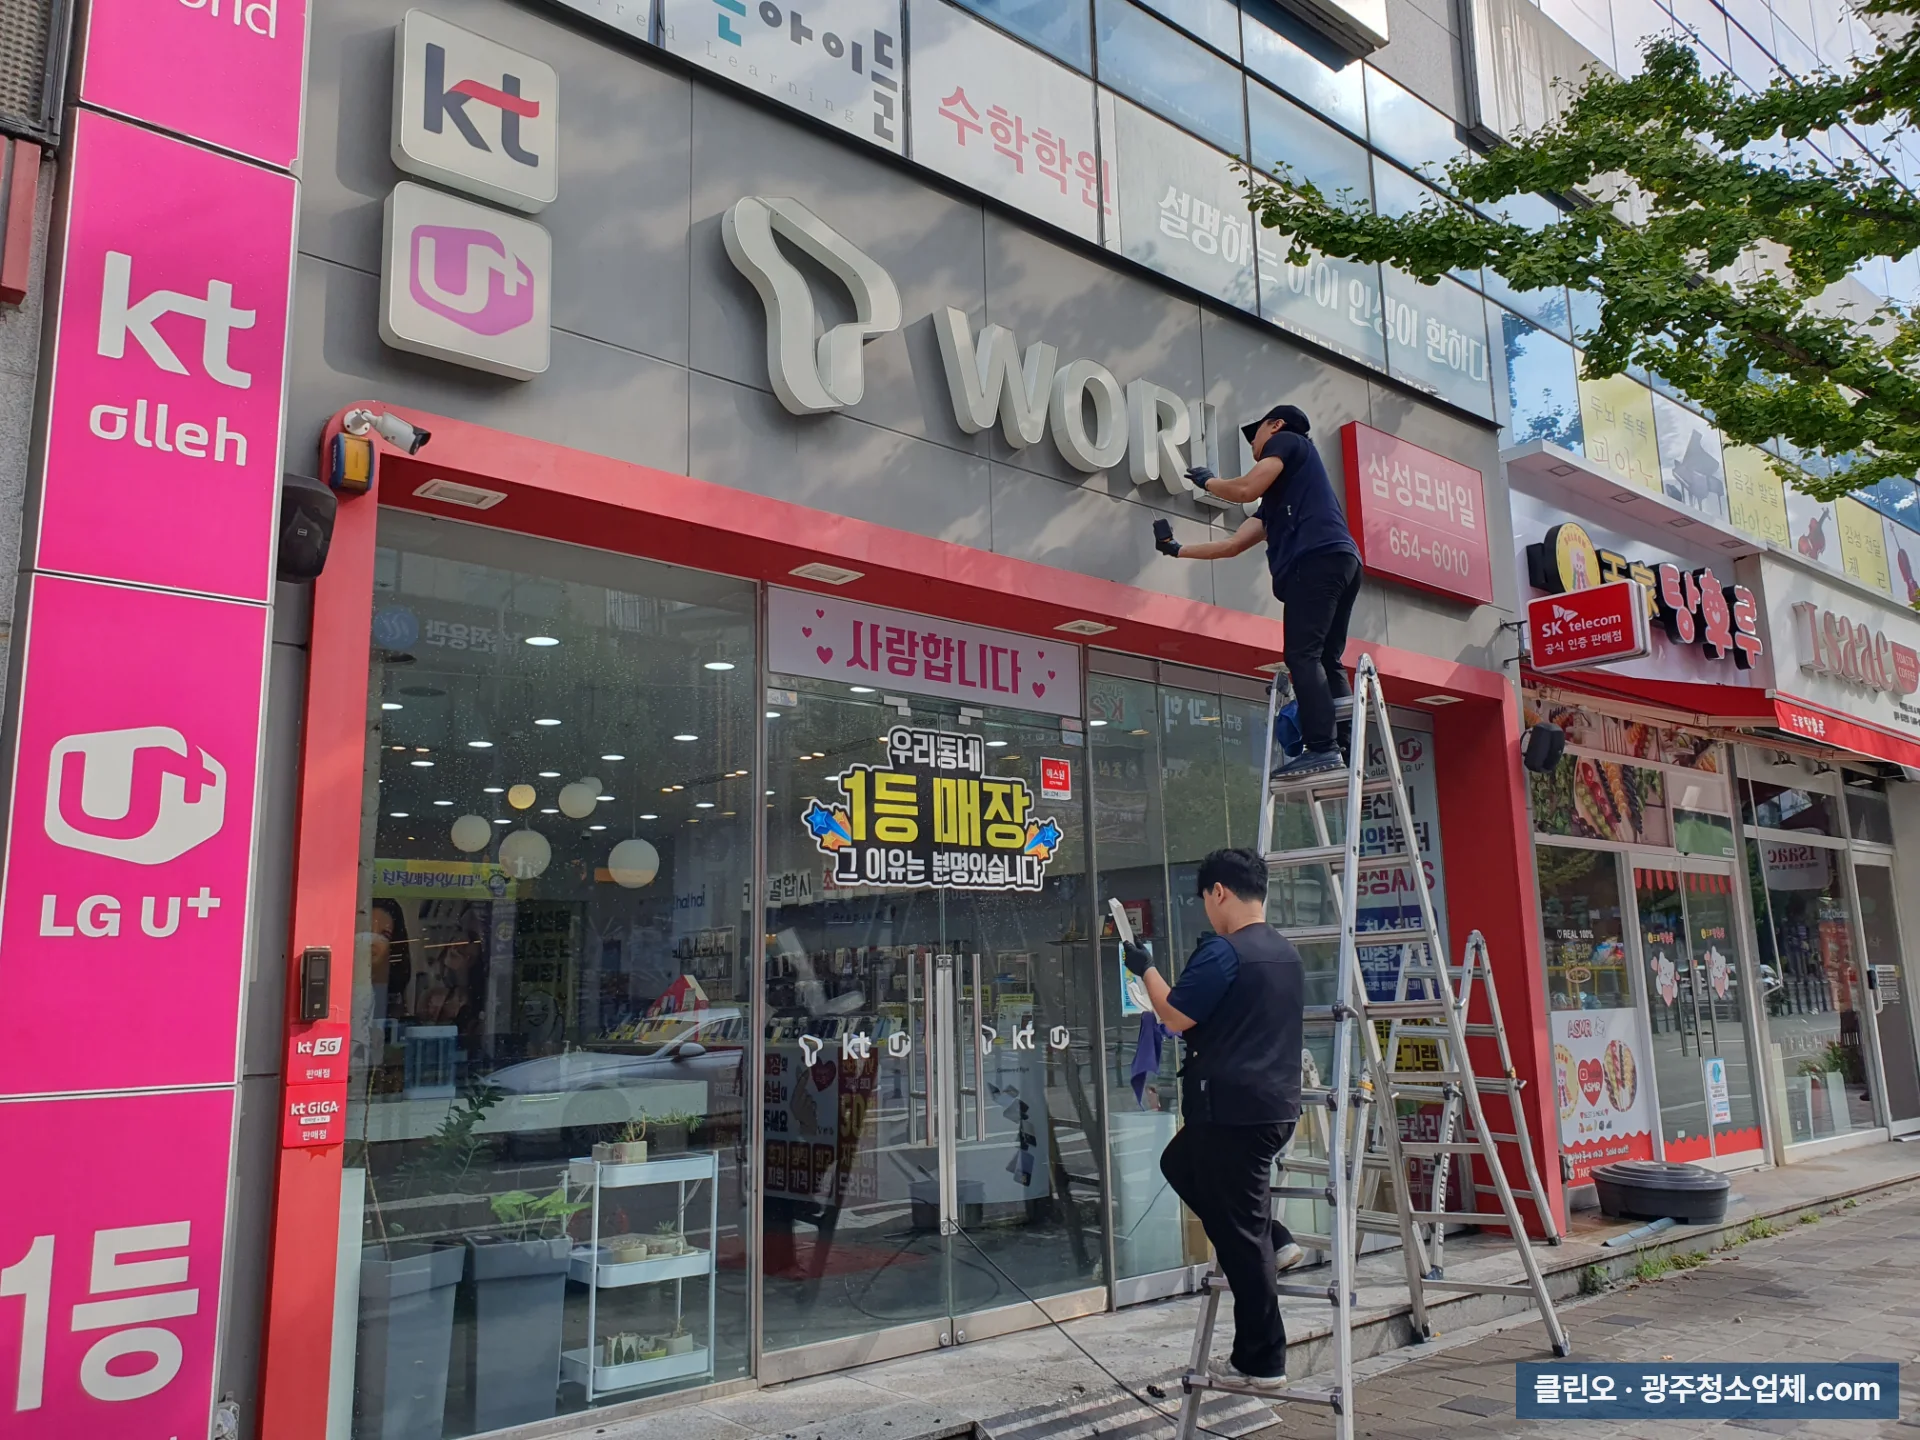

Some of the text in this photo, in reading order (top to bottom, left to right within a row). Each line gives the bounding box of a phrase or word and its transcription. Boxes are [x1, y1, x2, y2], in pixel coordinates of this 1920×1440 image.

[423, 42, 540, 168] kt
[705, 40, 854, 123] Learning
[938, 85, 1112, 216] 수학학원
[97, 250, 257, 390] kt
[1348, 277, 1418, 348] 인생이
[1426, 315, 1489, 383] 환하다
[88, 398, 249, 467] olleh
[932, 305, 1263, 518] WORL
[1591, 395, 1648, 446] 두뇌 똑똑
[1591, 435, 1654, 488] 피아노
[1367, 451, 1476, 531] 삼성모바일
[1732, 503, 1787, 547] 바이올린
[1388, 525, 1470, 579] 654-6010
[1541, 612, 1622, 639] SK telecom
[1544, 629, 1623, 656] 공식 인증 판매점
[1792, 601, 1894, 692] Isaac
[846, 619, 1022, 695] 사랑합니다
[891, 730, 981, 773] 우리동네
[1045, 767, 1066, 781] 에스원
[843, 769, 1030, 849] 1등 매장
[837, 848, 858, 881] 그
[865, 847, 926, 882] 이유는
[931, 851, 1043, 887] 분명있습니다
[39, 886, 221, 938] LG U+
[1563, 929, 1595, 939] REAL 100%
[297, 1039, 337, 1055] kt 5G
[842, 1031, 872, 1060] kt
[1012, 1024, 1035, 1050] kt
[1567, 1019, 1592, 1039] ASMR
[305, 1067, 331, 1080] 판매점
[290, 1100, 341, 1116] kt GiGA
[302, 1138, 328, 1152] 판매점
[0, 1219, 199, 1413] 1등
